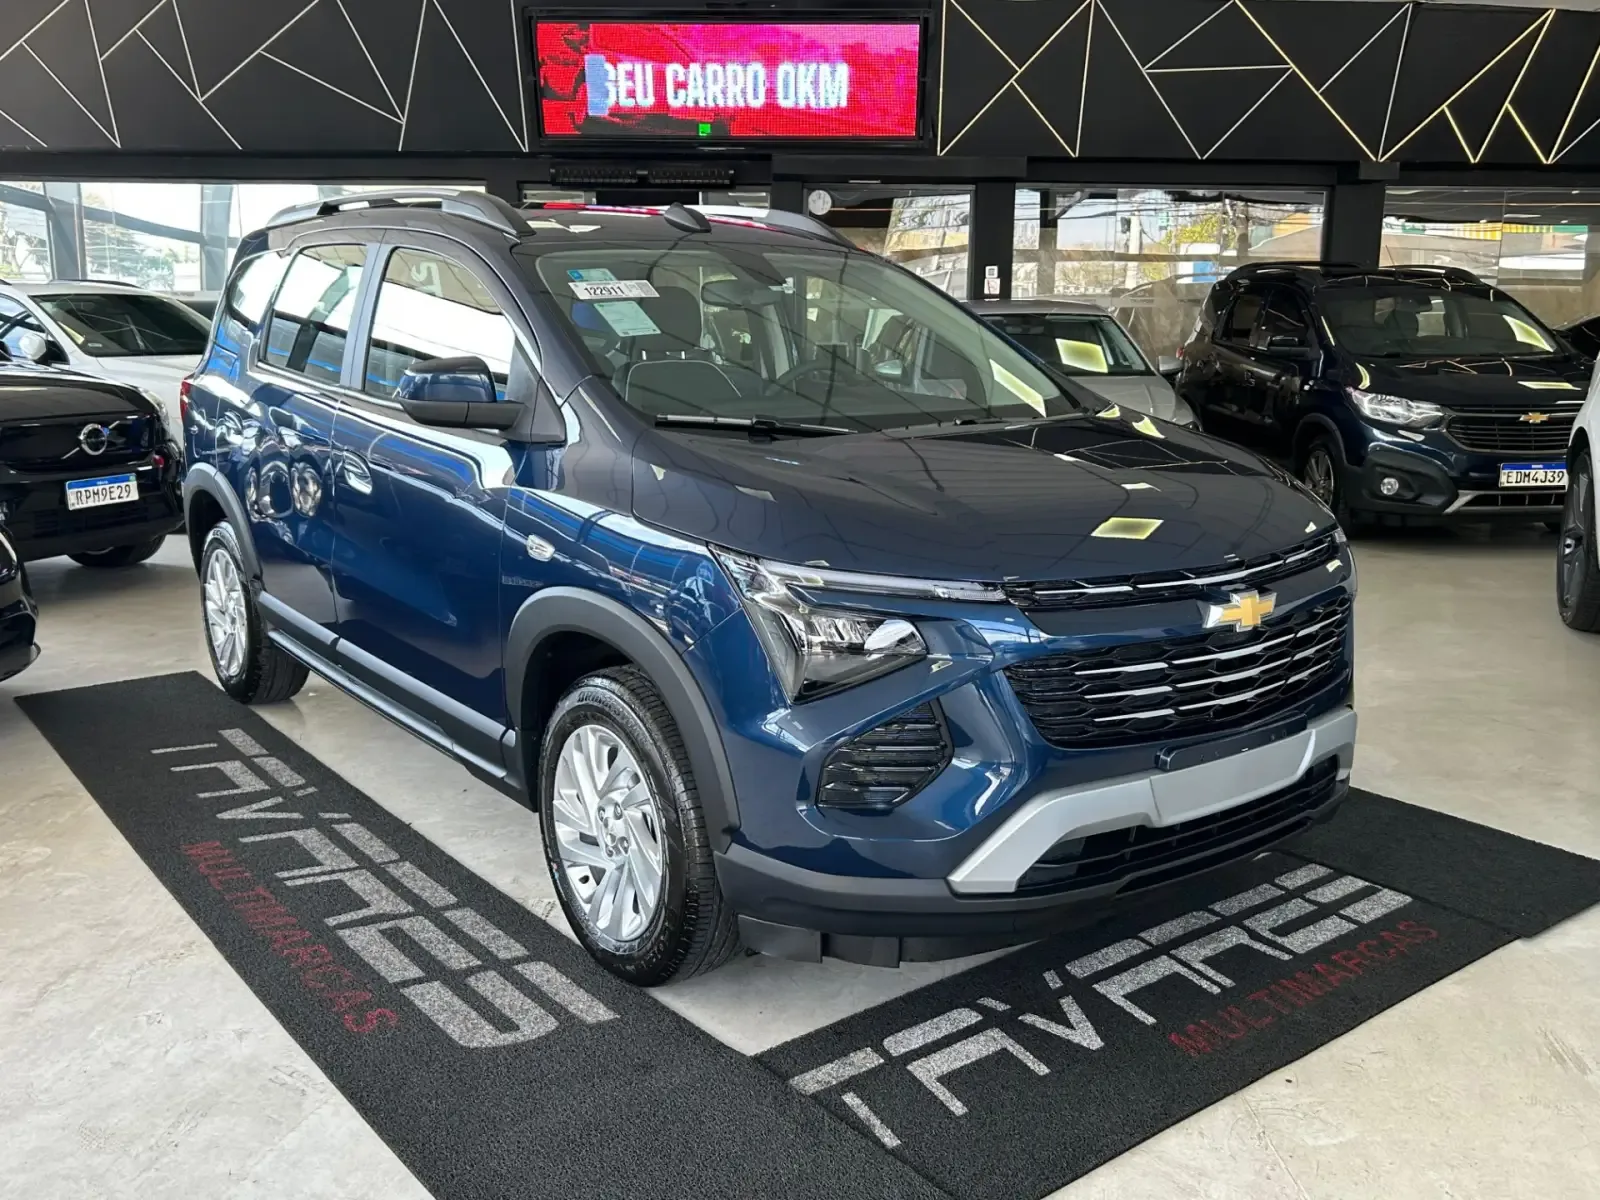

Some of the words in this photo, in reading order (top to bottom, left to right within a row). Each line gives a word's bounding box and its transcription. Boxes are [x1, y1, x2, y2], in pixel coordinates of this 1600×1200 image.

[665, 62, 767, 109] CARRO
[584, 285, 626, 297] 122911
[1506, 470, 1565, 485] EDM4J39
[75, 483, 132, 506] RPM9E29
[1167, 920, 1439, 1058] MULTIMARCAS
